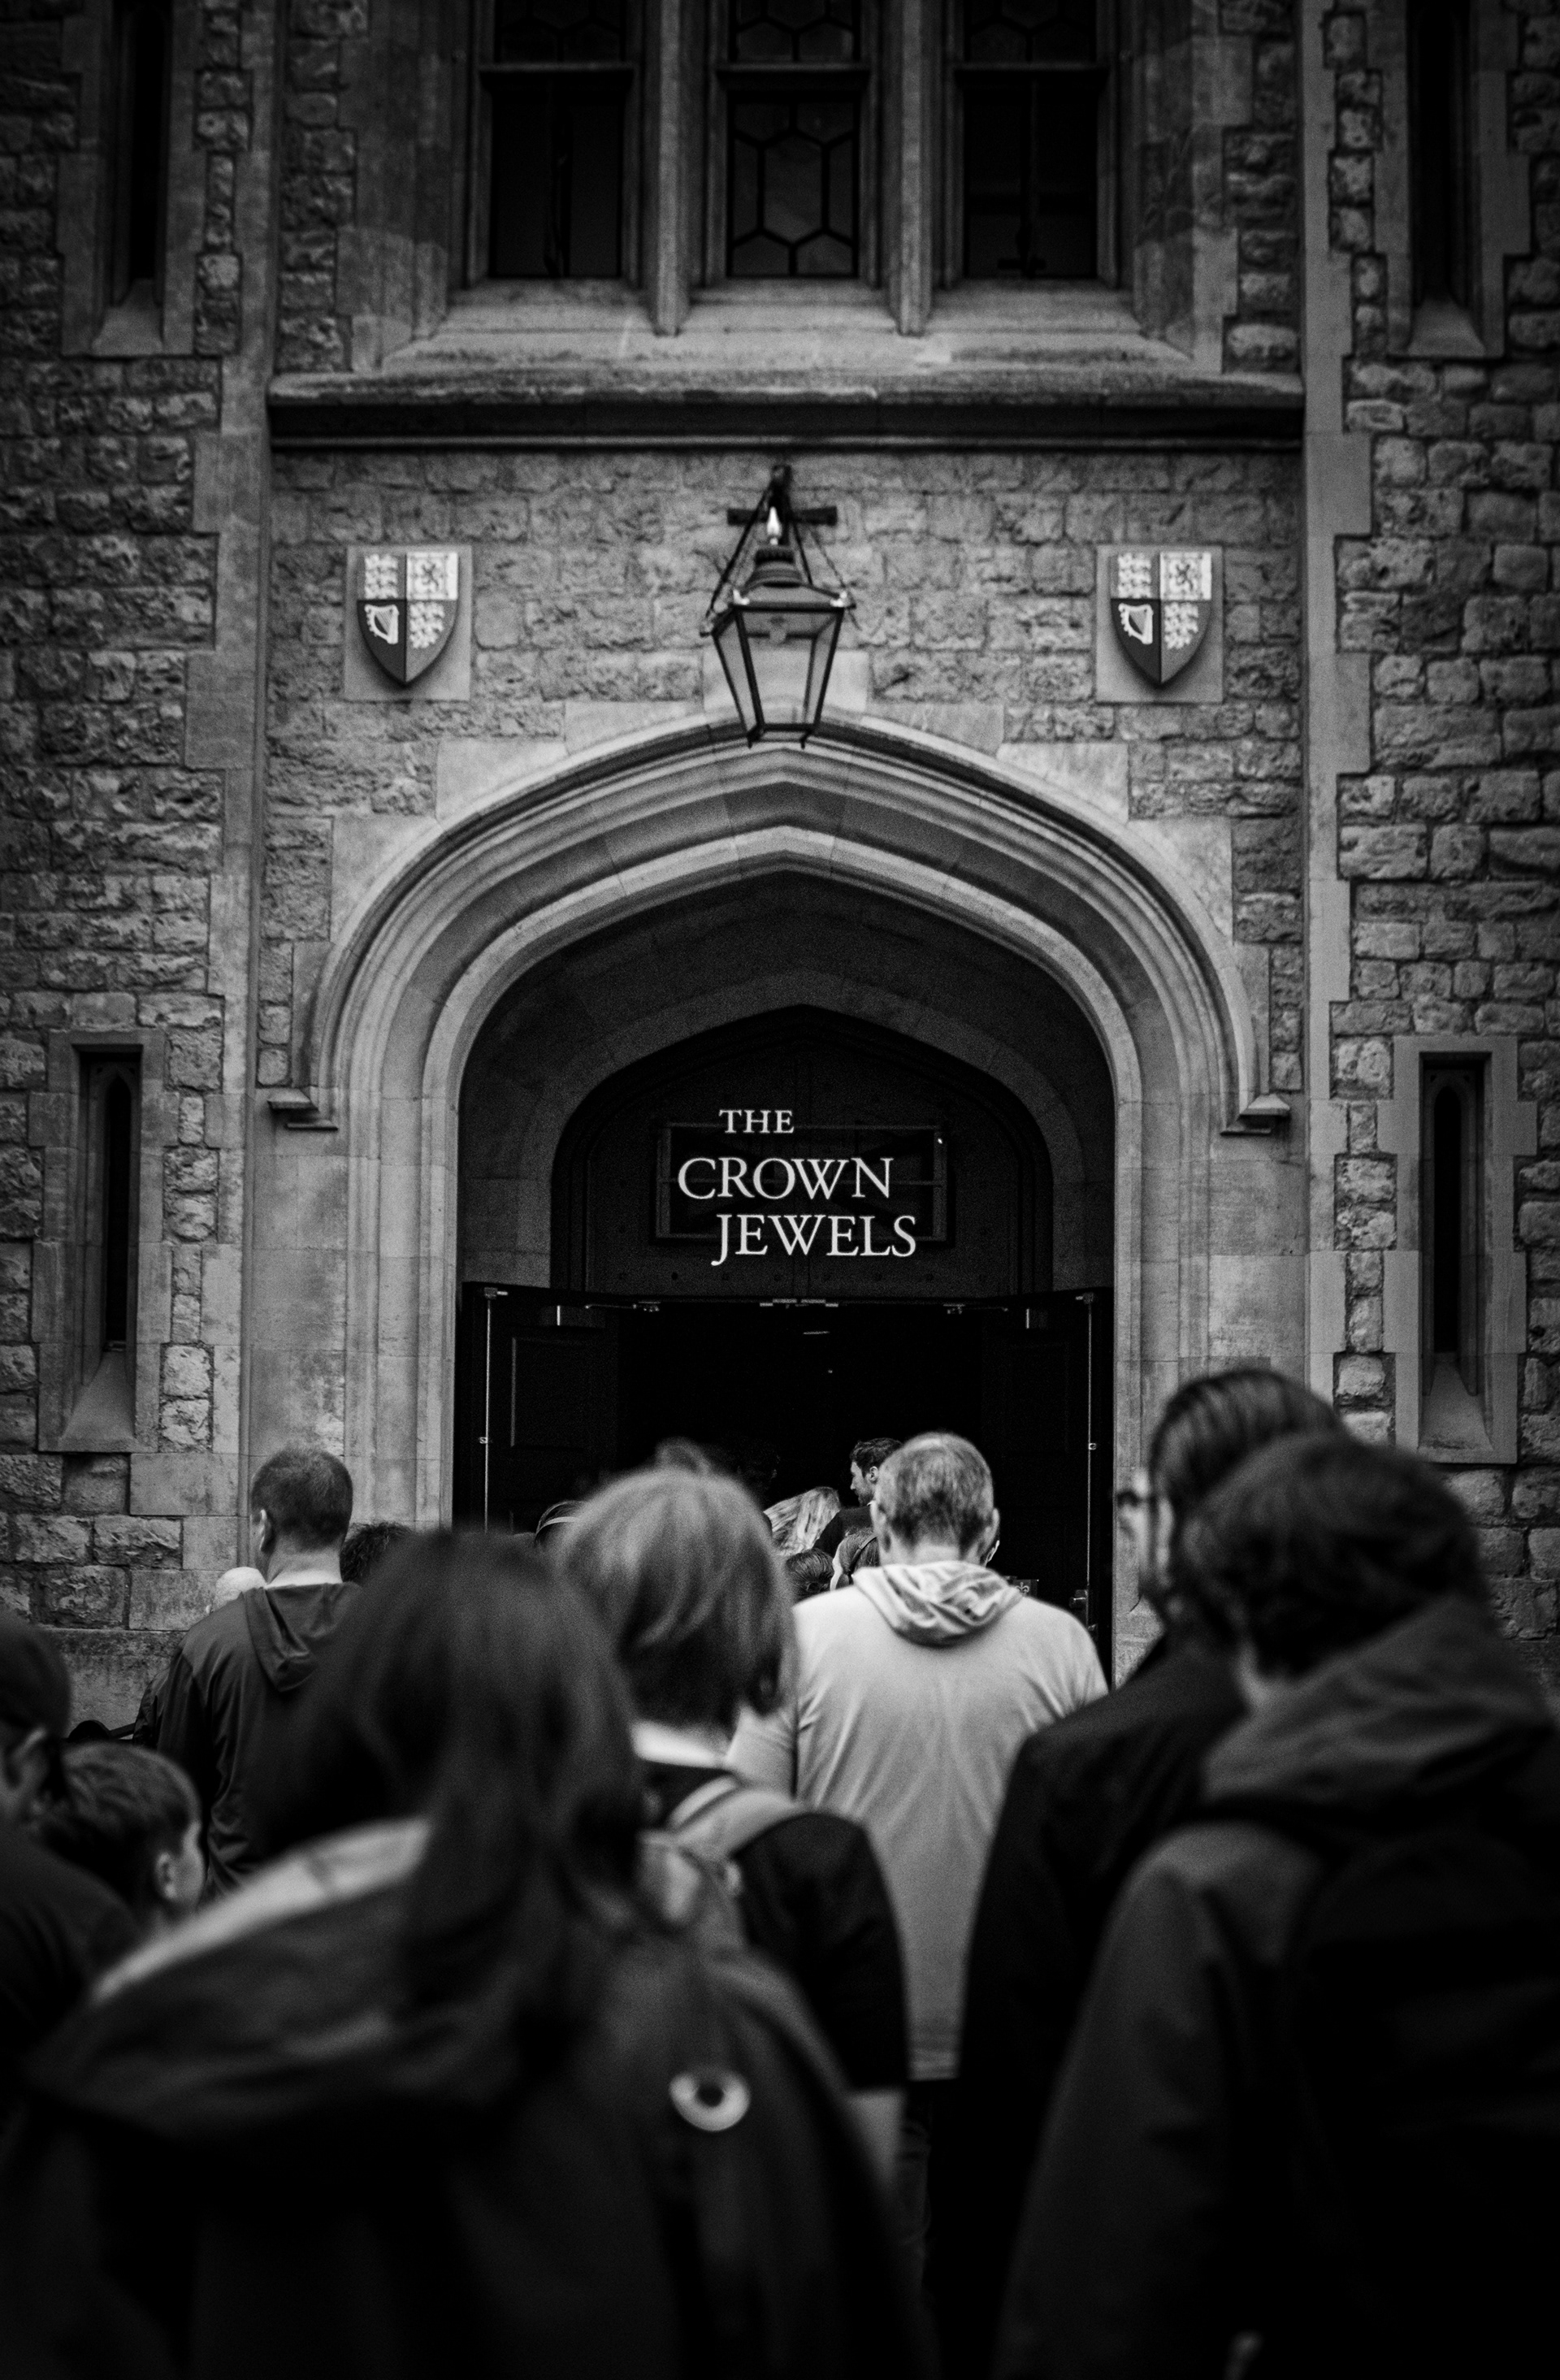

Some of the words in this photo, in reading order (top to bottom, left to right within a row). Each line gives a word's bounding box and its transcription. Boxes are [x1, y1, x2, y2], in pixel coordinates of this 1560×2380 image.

[718, 1109, 795, 1134] THE
[678, 1157, 894, 1200] CROWN
[711, 1214, 916, 1267] JEWELS
